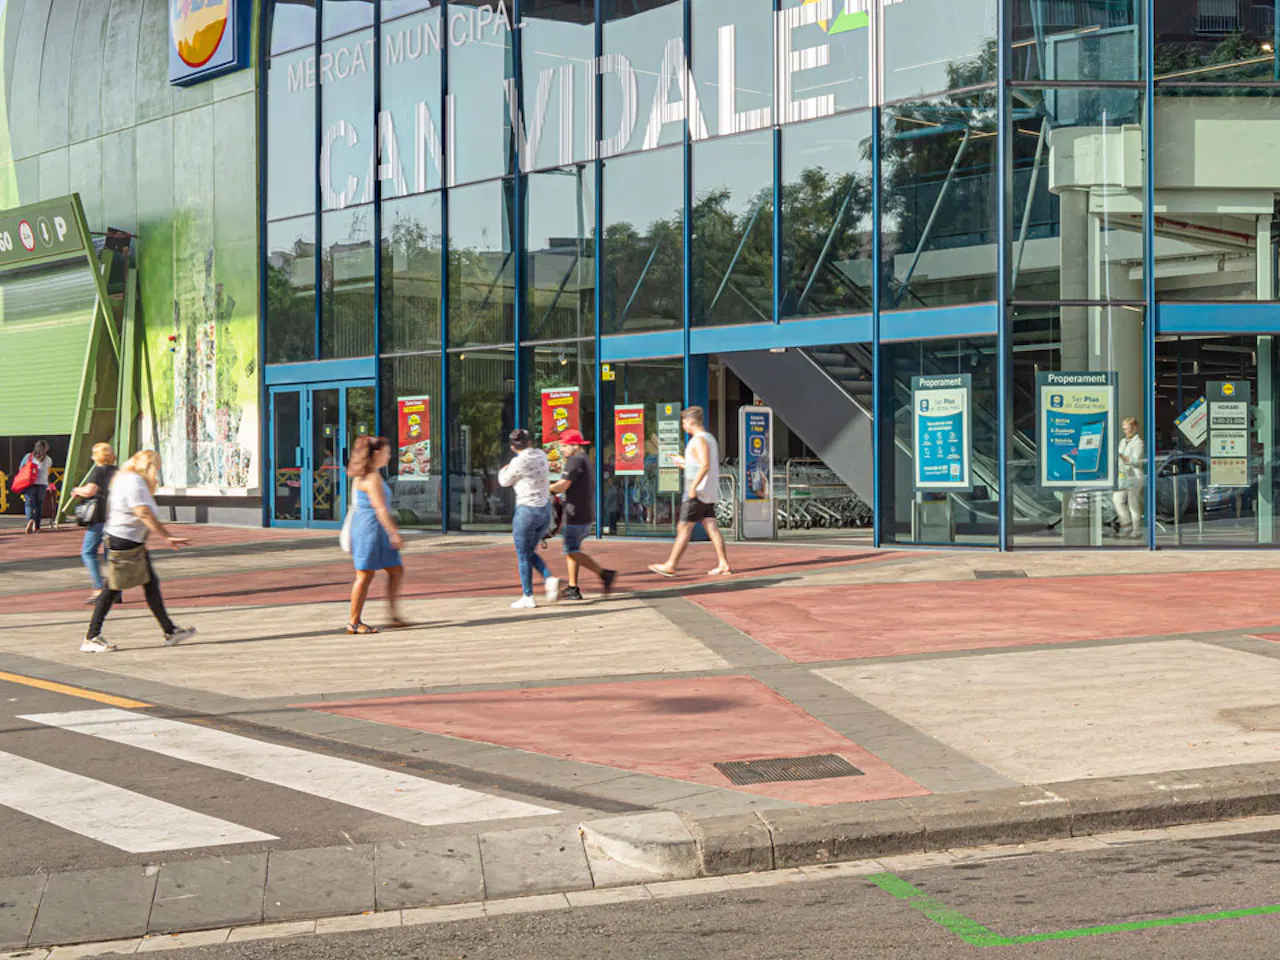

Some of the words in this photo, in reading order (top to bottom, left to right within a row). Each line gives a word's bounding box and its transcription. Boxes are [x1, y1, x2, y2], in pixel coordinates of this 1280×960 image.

[287, 38, 379, 93] MERCAT
[320, 94, 457, 209] CAN
[53, 215, 67, 242] P
[919, 376, 962, 388] Properament
[1047, 373, 1107, 385] Properament
